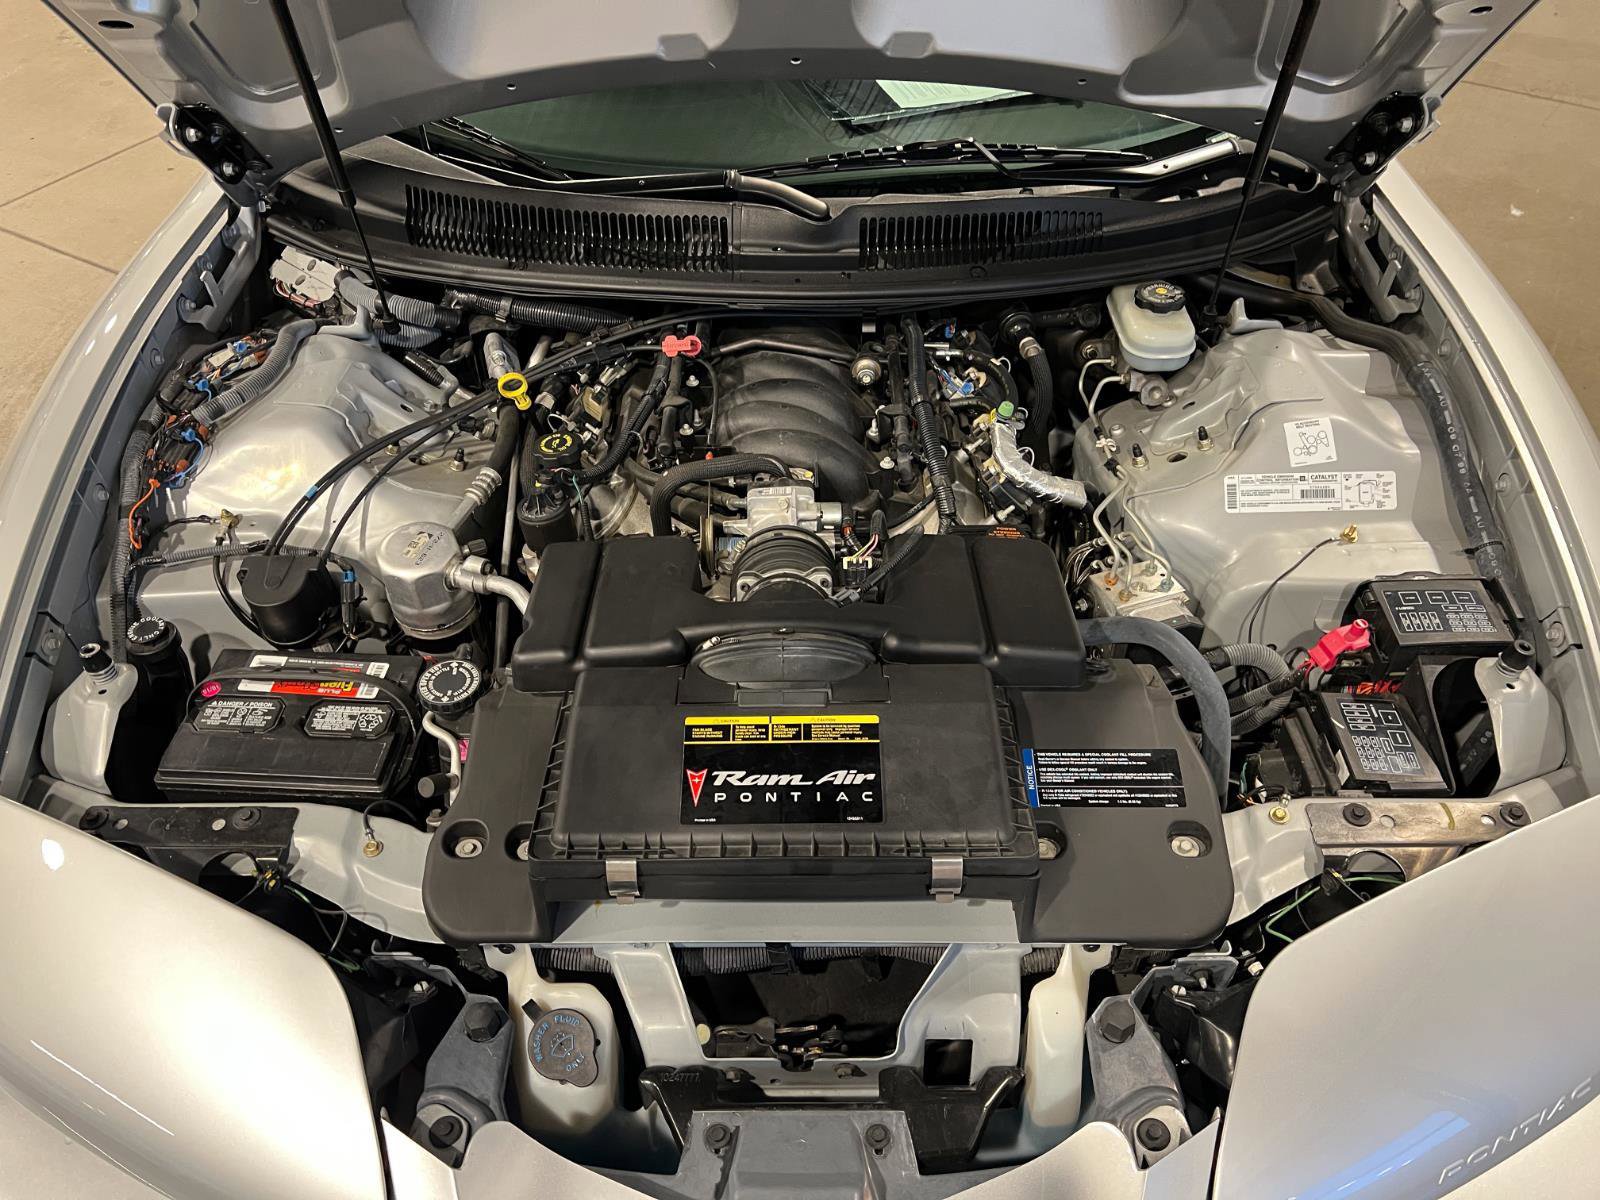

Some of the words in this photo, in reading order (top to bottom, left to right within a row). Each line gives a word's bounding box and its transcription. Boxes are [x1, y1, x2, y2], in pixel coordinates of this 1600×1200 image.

[712, 770, 814, 786] Ram
[815, 770, 876, 785] Air
[1027, 765, 1035, 790] NOTICE
[714, 792, 873, 803] PONTIAC
[554, 1015, 581, 1026] FLUID
[533, 1021, 552, 1063] WASHER
[565, 1049, 585, 1072] ONLY
[1438, 1077, 1591, 1185] PONTIAC
